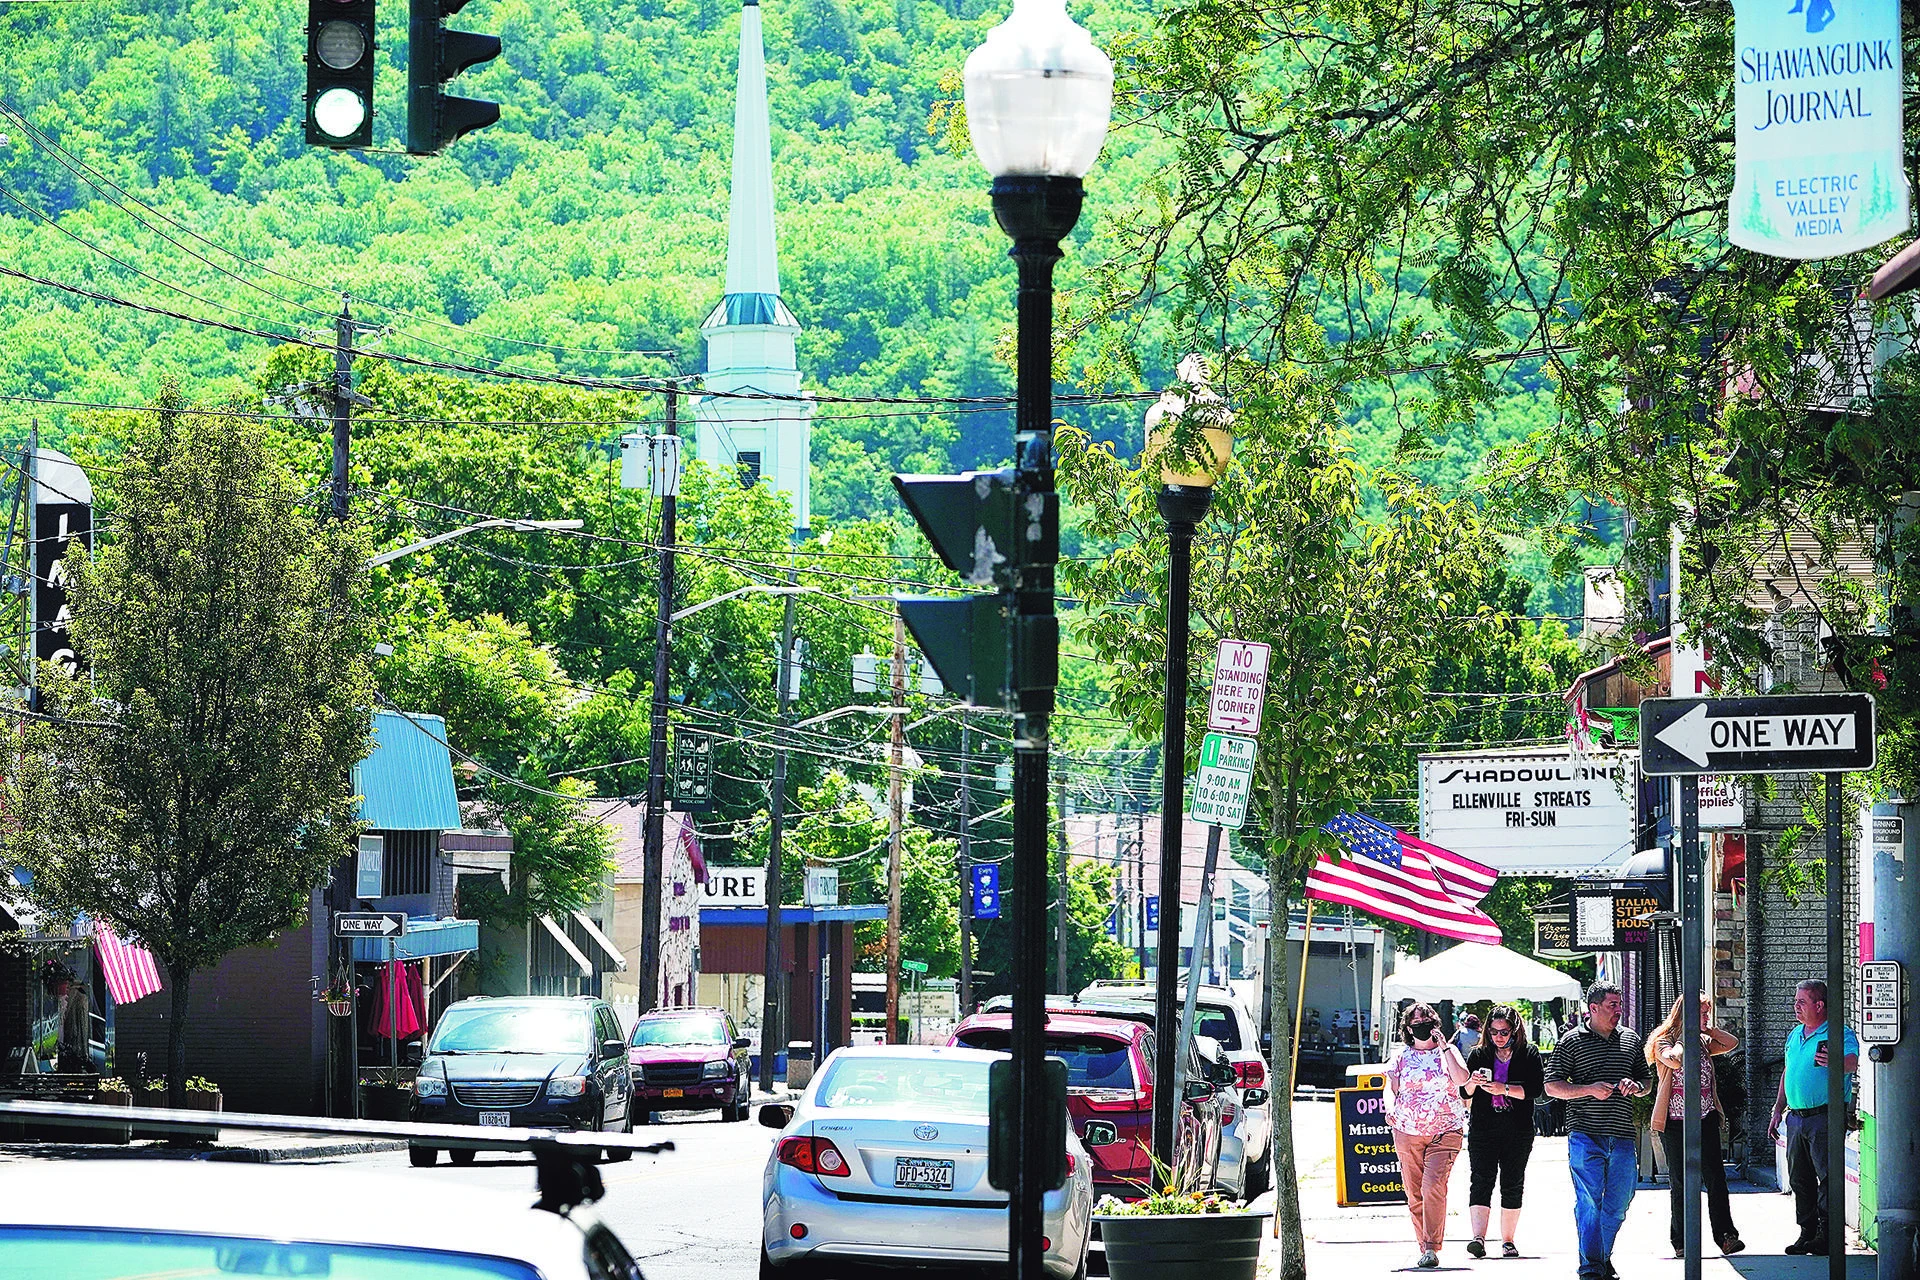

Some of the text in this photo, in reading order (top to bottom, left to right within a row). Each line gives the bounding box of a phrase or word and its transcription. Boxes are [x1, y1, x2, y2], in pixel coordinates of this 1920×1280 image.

[1740, 40, 1893, 84] SHAWANGUNK
[1754, 88, 1872, 131] JOURNAL
[1776, 174, 1859, 196] ELECTRIC
[1786, 196, 1850, 216] VALLEY
[1795, 218, 1842, 237] MEDIA
[1232, 650, 1253, 669] NO
[1218, 669, 1262, 684] STANDING
[1216, 685, 1259, 700] HERE TO
[1217, 700, 1256, 714] CORNER
[1710, 718, 1846, 748] ONE WAY
[1207, 739, 1244, 762] 1 HR
[1218, 753, 1250, 770] PARKING
[1206, 774, 1240, 790] 9:00 AM
[1438, 766, 1626, 784] SHADOWLAND
[1198, 786, 1244, 805] TO 6:00 PM
[1698, 786, 1727, 796] ffice
[1452, 790, 1591, 809] ELLENVILLE STREATS
[1700, 797, 1734, 808] pplies
[1195, 802, 1242, 818] MON TO SAT
[1506, 811, 1556, 827] FRI-SUN
[704, 876, 756, 897] URE
[1616, 898, 1658, 907] ITALIAN
[1616, 906, 1658, 917] STEAK
[342, 920, 382, 930] ONE WAY
[1616, 918, 1654, 928] HOUS
[1356, 1098, 1386, 1114] OPE
